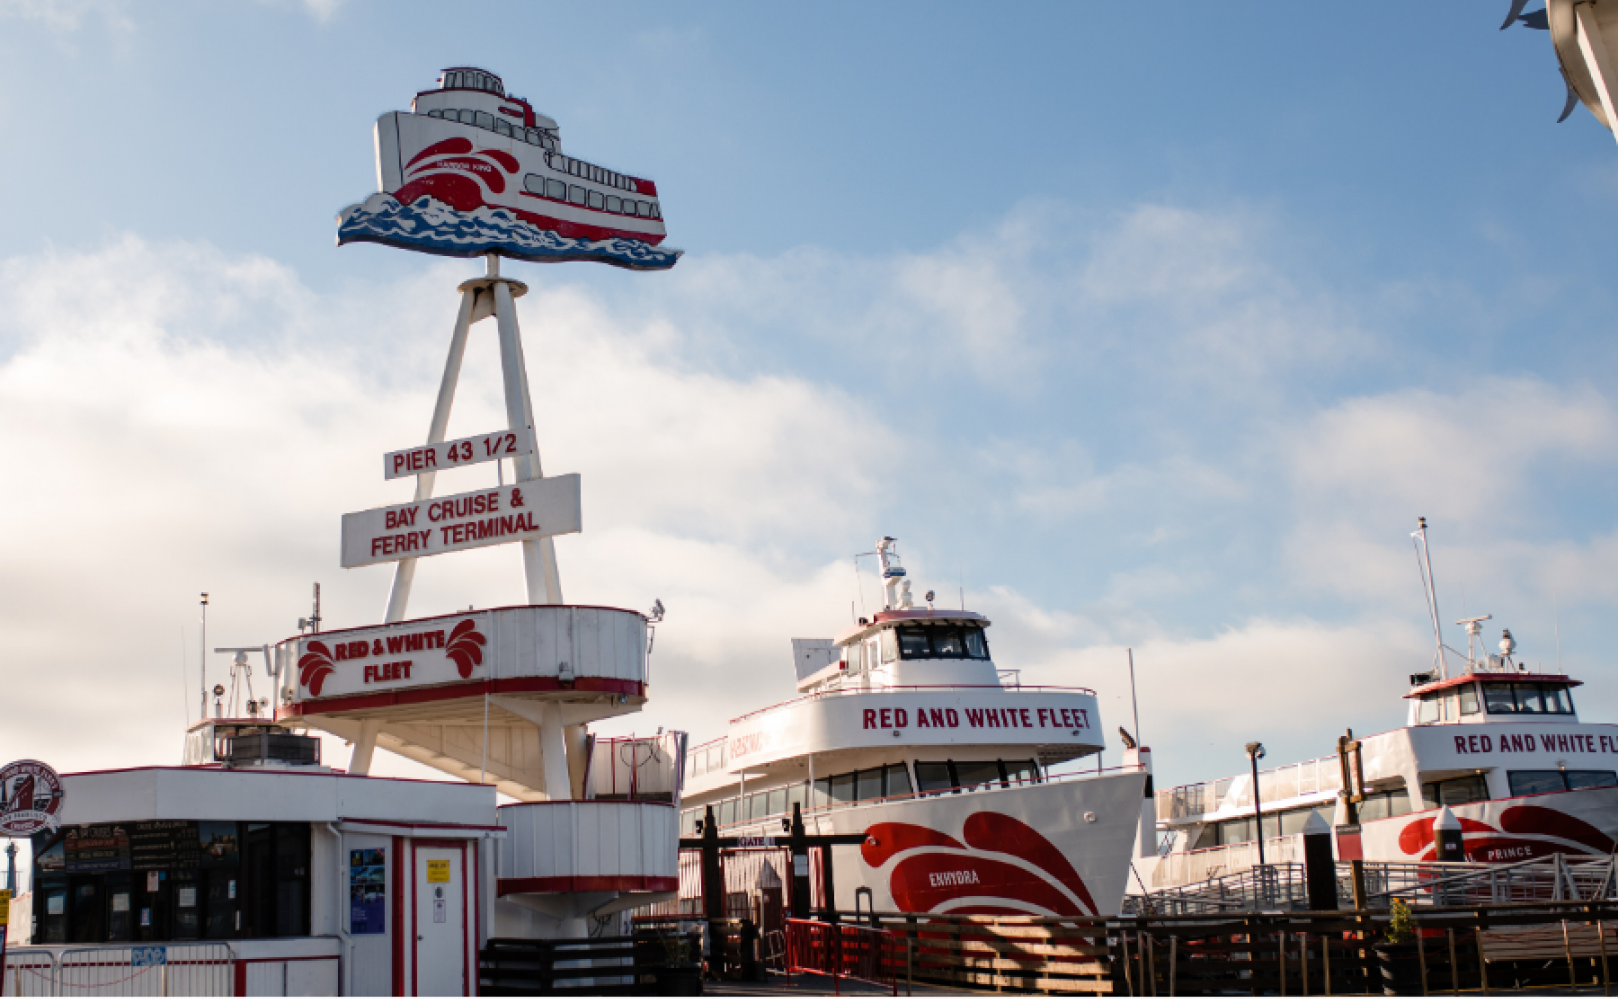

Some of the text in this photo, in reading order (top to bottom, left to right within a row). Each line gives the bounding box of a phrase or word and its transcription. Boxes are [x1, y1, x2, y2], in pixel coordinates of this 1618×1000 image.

[394, 433, 517, 474] PIER 43 1/2
[385, 488, 525, 530] BAY CRUISE &
[371, 511, 540, 557] FERRY TERMINAL
[335, 629, 445, 662] RED & WHITE
[363, 660, 413, 684] FLEET
[863, 708, 1091, 729] RED AND WHITE FLEET
[1454, 735, 1493, 754] RED
[1500, 734, 1537, 753] AND
[1540, 734, 1598, 753] WHITE
[739, 837, 764, 846] GATE
[1488, 846, 1532, 860] PRINCE
[929, 869, 980, 887] ENHYDRA
